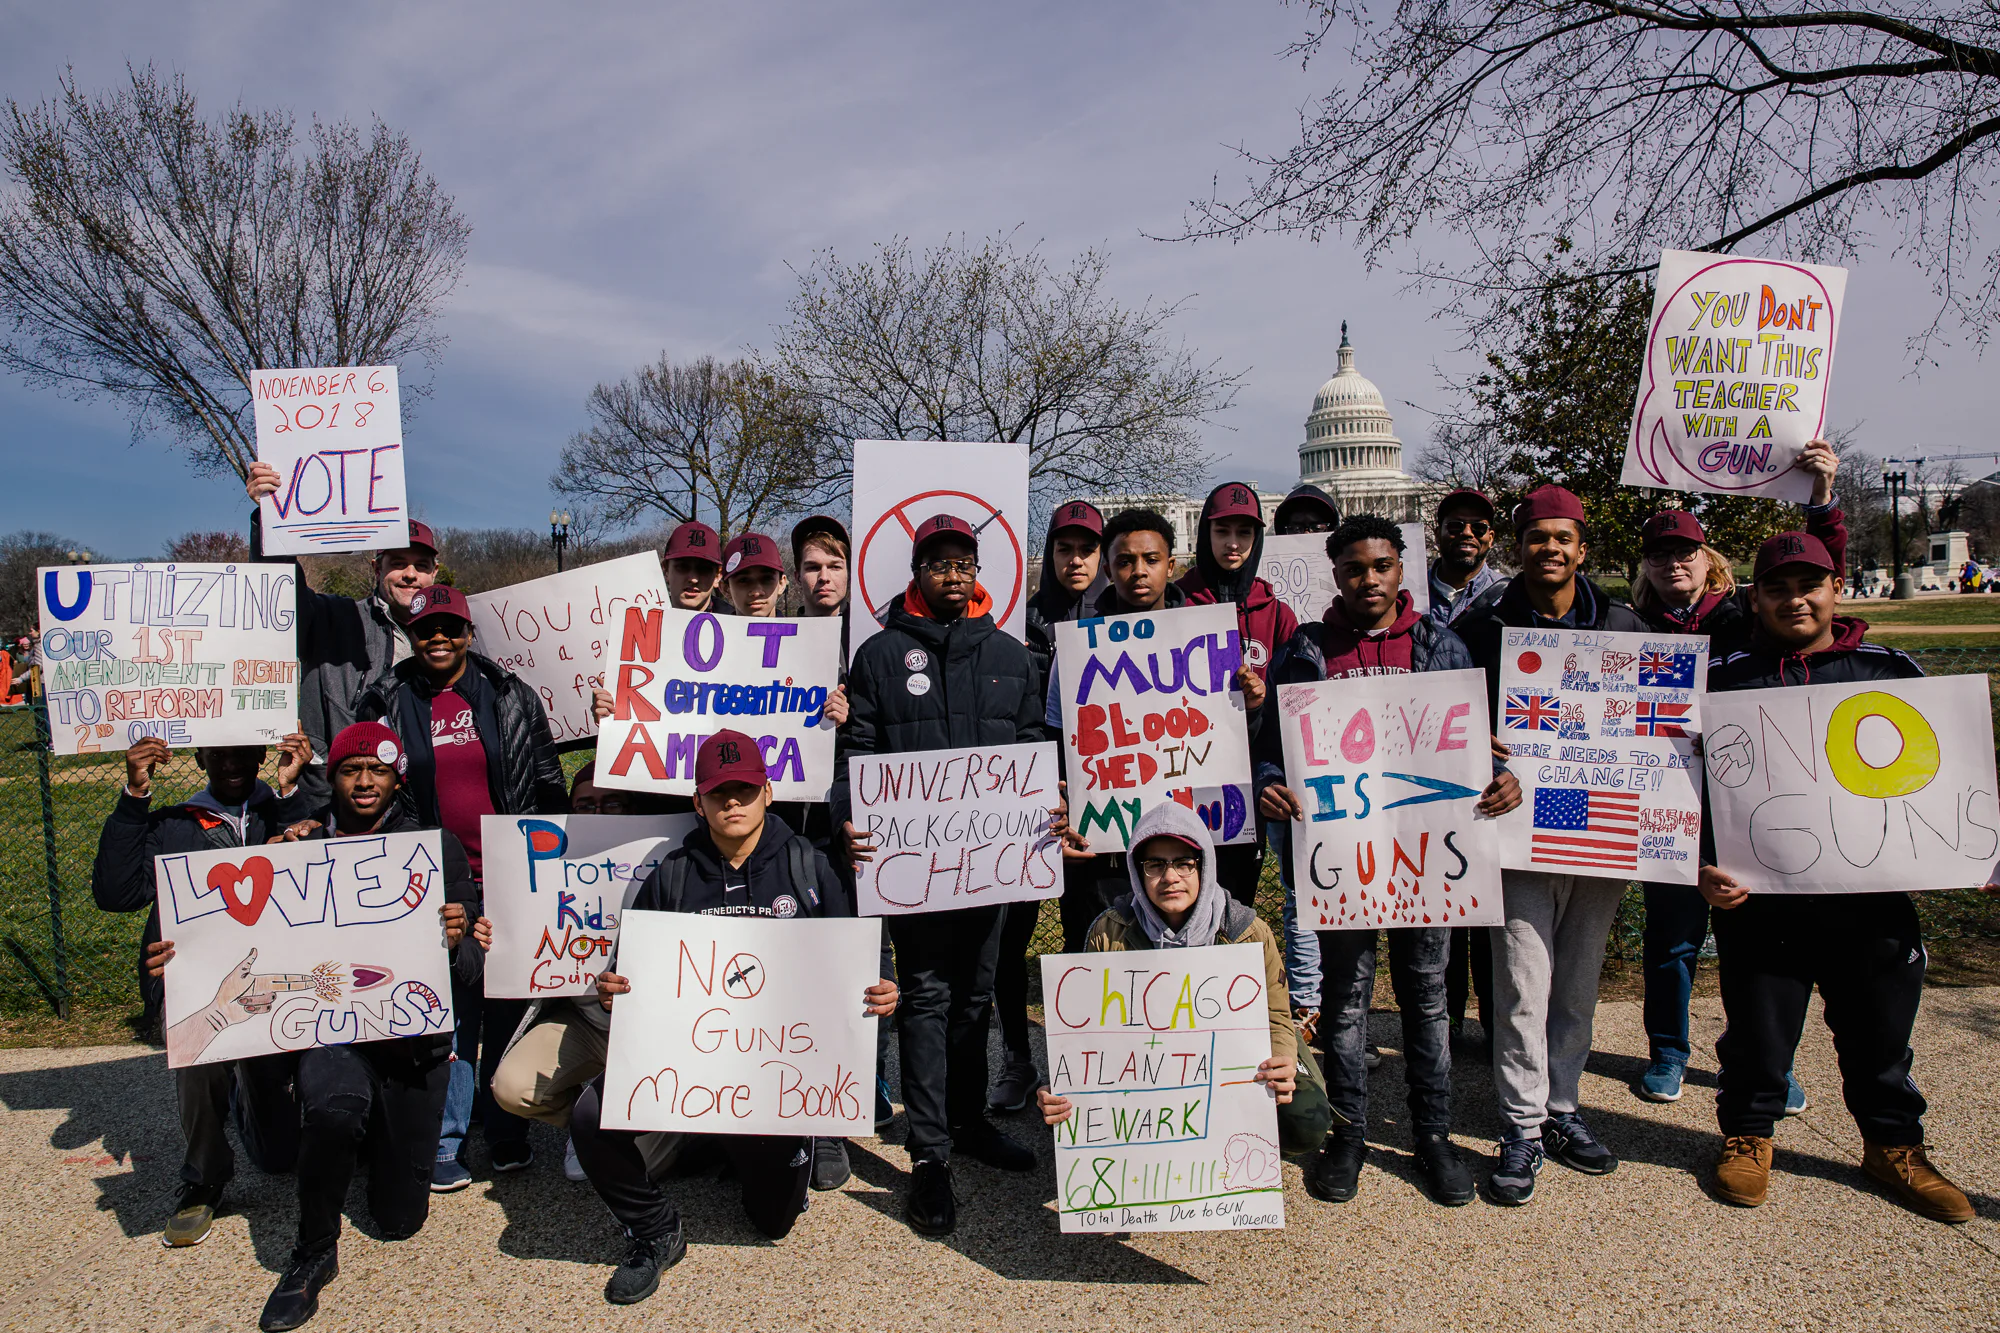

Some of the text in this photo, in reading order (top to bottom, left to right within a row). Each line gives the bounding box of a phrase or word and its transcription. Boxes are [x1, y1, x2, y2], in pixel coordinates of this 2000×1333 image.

[1688, 284, 1823, 332] YOU DON'T
[1665, 333, 1823, 380] WANT THIS
[258, 372, 357, 400] NOVEMBER
[1673, 379, 1800, 412] TEACHER
[273, 401, 375, 433] 2018
[1682, 412, 1773, 439] WITH A
[269, 444, 400, 519] VOTE
[42, 626, 203, 665] OUR 1ST
[558, 645, 574, 661] a
[620, 606, 798, 673] NOT
[1507, 631, 1560, 649] JAPAN
[1638, 640, 1710, 654] AUSTRALIA
[51, 659, 225, 691] AMENDMENT
[232, 659, 298, 686] RIGHT
[1076, 630, 1243, 705] MUCH
[1562, 671, 1590, 682] GUN
[1564, 652, 1577, 671] 6
[1560, 680, 1600, 692] DEATHS
[1637, 692, 1690, 703] NORWAY
[48, 687, 288, 725] TO REFORM THE
[1560, 702, 1585, 722] 26
[1604, 698, 1636, 718] 30%
[1077, 702, 1210, 756] BLOOD
[1299, 702, 1471, 766] LOVE
[1557, 730, 1591, 740] DEATHS
[1560, 720, 1586, 731] GUN
[1559, 746, 1618, 764] NEEDS
[1630, 750, 1660, 767] TO
[1668, 753, 1691, 769] BE
[1759, 690, 1941, 798] NO
[858, 752, 1043, 807] UNIVERSAL
[1082, 740, 1212, 791] SHED IN
[1538, 765, 1664, 791] CHANGE!!
[1304, 772, 1371, 823] IS
[867, 806, 1053, 849] BACKGROUND
[1077, 795, 1142, 850] MY
[1639, 847, 1688, 861] DEATHS
[1642, 834, 1675, 848] GUN
[875, 840, 1058, 908] CHECKS
[1310, 831, 1468, 890] GUNS
[162, 837, 420, 927] LOVE
[402, 873, 427, 908] UP
[557, 891, 619, 930] Kids
[407, 981, 440, 1009] DOWN
[270, 981, 440, 1051] GUNS
[1053, 1051, 1208, 1087] ATLANTA
[1058, 1100, 1200, 1145] NEWARK
[1120, 1207, 1158, 1227] Deaths
[1202, 1202, 1213, 1217] to
[1215, 1200, 1245, 1216] GUN
